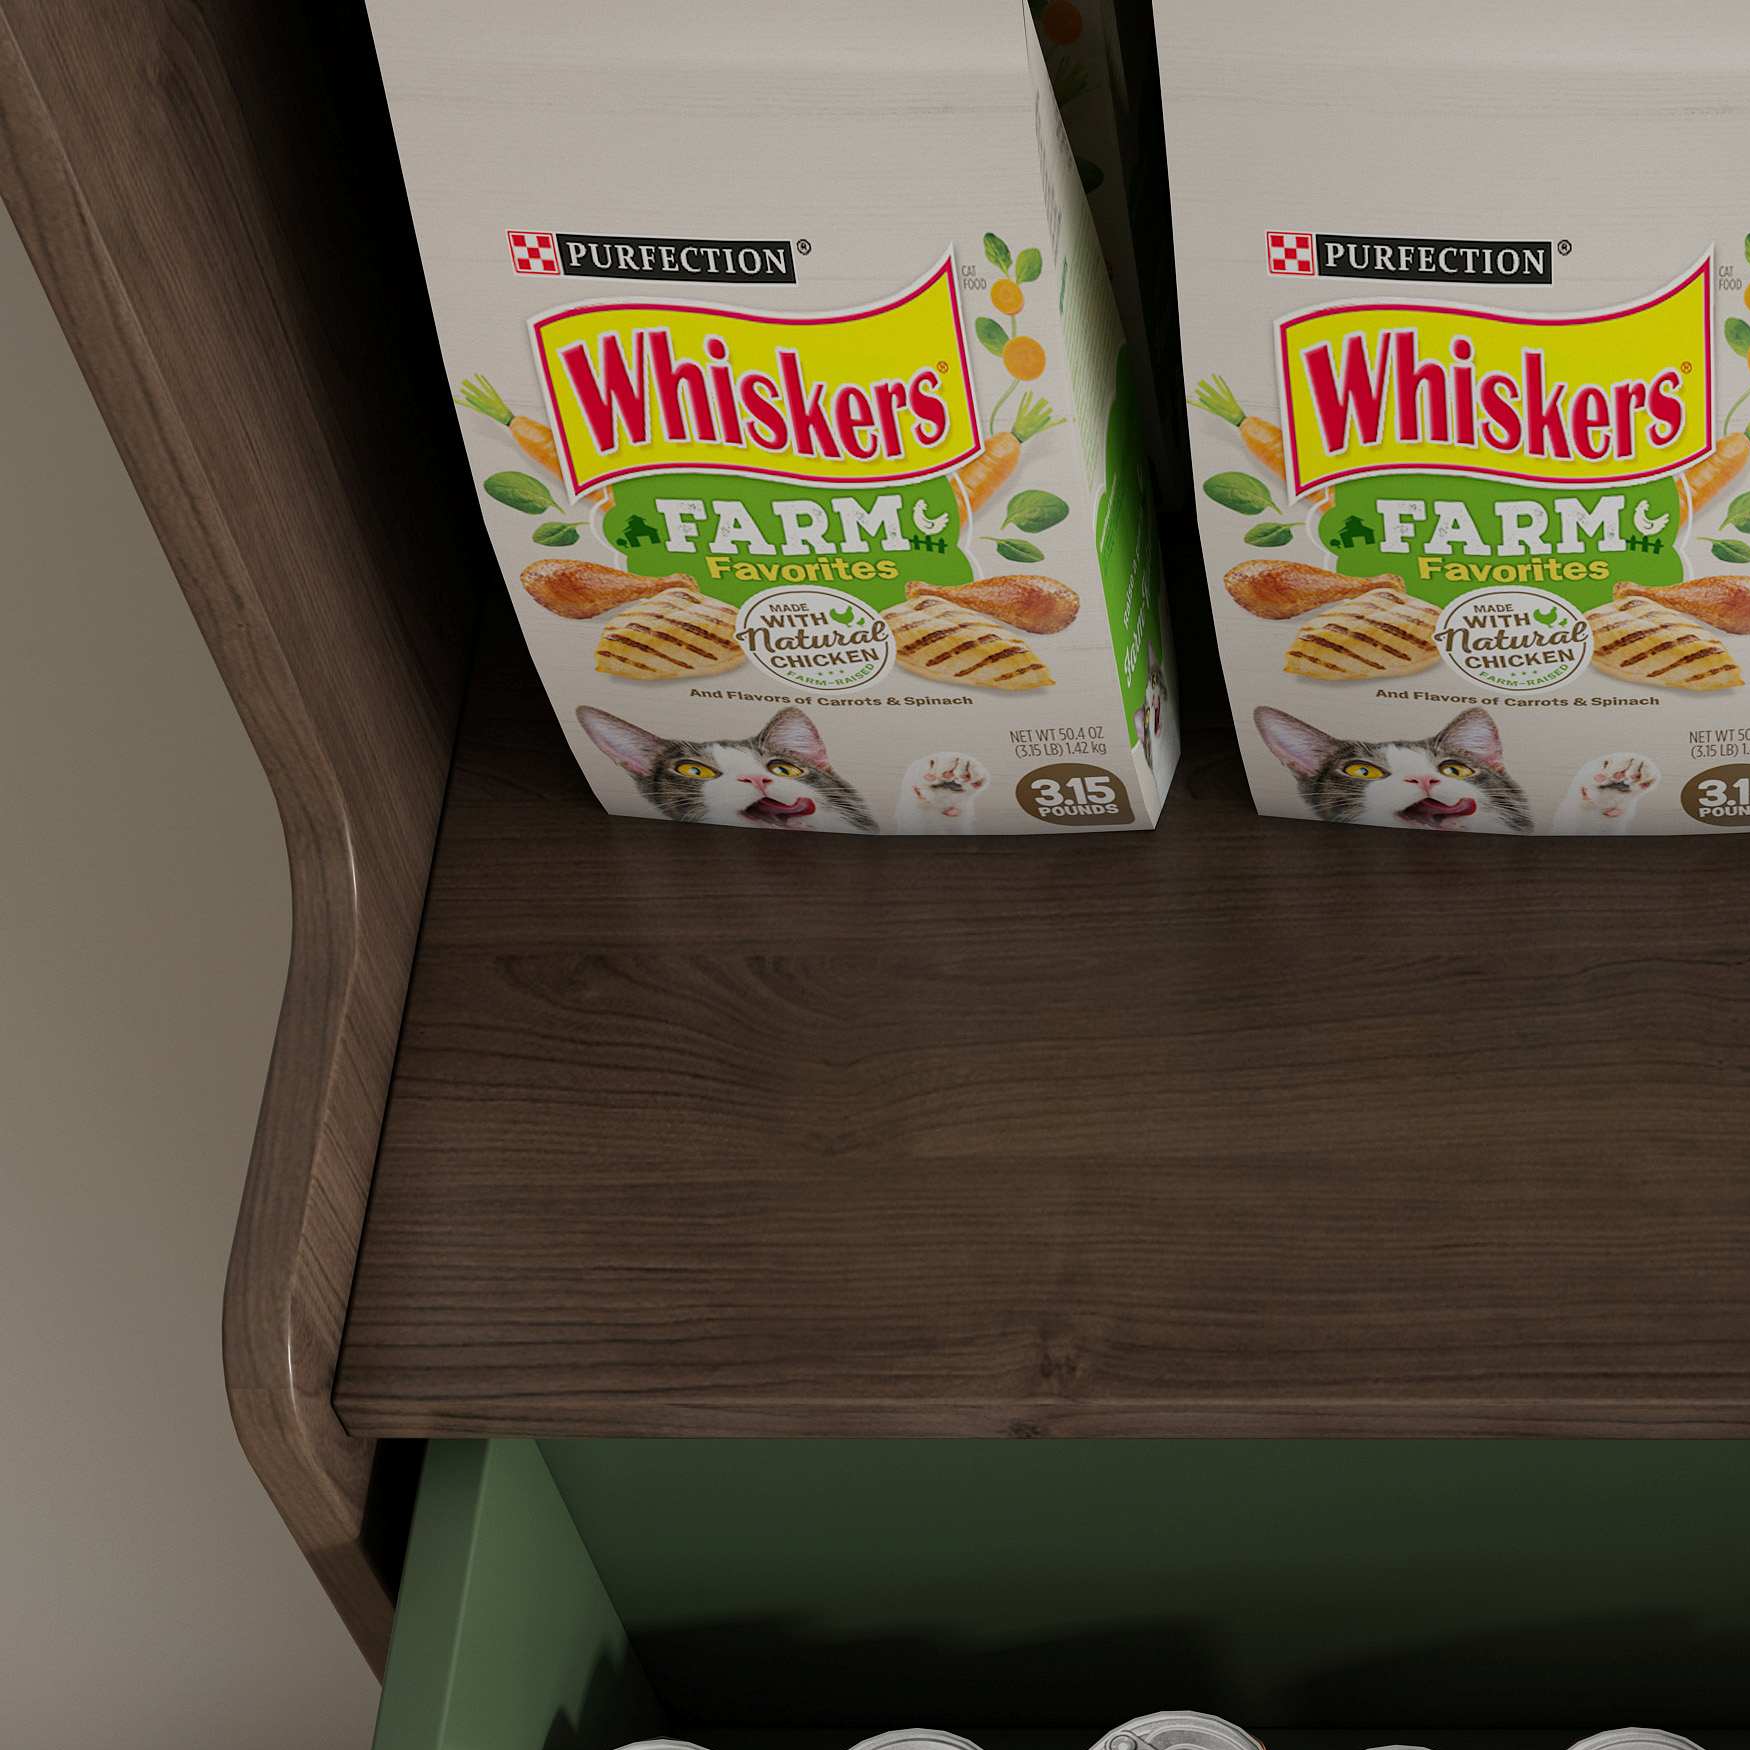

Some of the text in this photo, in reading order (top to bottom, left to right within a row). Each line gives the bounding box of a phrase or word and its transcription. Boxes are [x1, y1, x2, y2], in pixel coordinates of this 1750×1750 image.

[566, 241, 787, 276] PURFECTION
[1326, 242, 1545, 275] PURFECTION
[961, 265, 976, 277] CAT
[1719, 266, 1734, 277] CAT
[963, 277, 987, 290] FOOD
[1719, 277, 1742, 290] FOOD
[557, 328, 949, 460] Whiskers
[1301, 330, 1684, 461] Whiskers
[655, 494, 911, 556] FARM
[1376, 496, 1626, 556] FARM
[705, 556, 899, 583] Favorites
[1420, 557, 1609, 583] Favorites
[769, 602, 809, 613] MADE
[1473, 603, 1513, 614] MADE
[760, 612, 828, 629] WITH
[1462, 612, 1530, 629] WITH
[735, 619, 889, 653] Natural
[1433, 620, 1588, 653] Natural
[771, 648, 879, 670] CHICKEN
[1464, 649, 1575, 670] CHICKEN
[786, 662, 875, 687] FARM-RAISED
[1479, 663, 1568, 687] FARM-RAISED
[690, 688, 973, 708] And Flavors of Carrots & Spinach
[1375, 689, 1659, 708] And Flavors of Carrots & Spinach
[1010, 726, 1105, 743] NET WT 50.4 OZ
[1690, 731, 1711, 744] NET
[1716, 730, 1735, 743] WT
[1015, 741, 1106, 759] (3.15 LB) 1.42 kg
[1691, 745, 1717, 759] (3.15
[1720, 744, 1739, 758] LB)
[1031, 776, 1116, 807] 3.15
[1038, 803, 1119, 818] POUNDS
